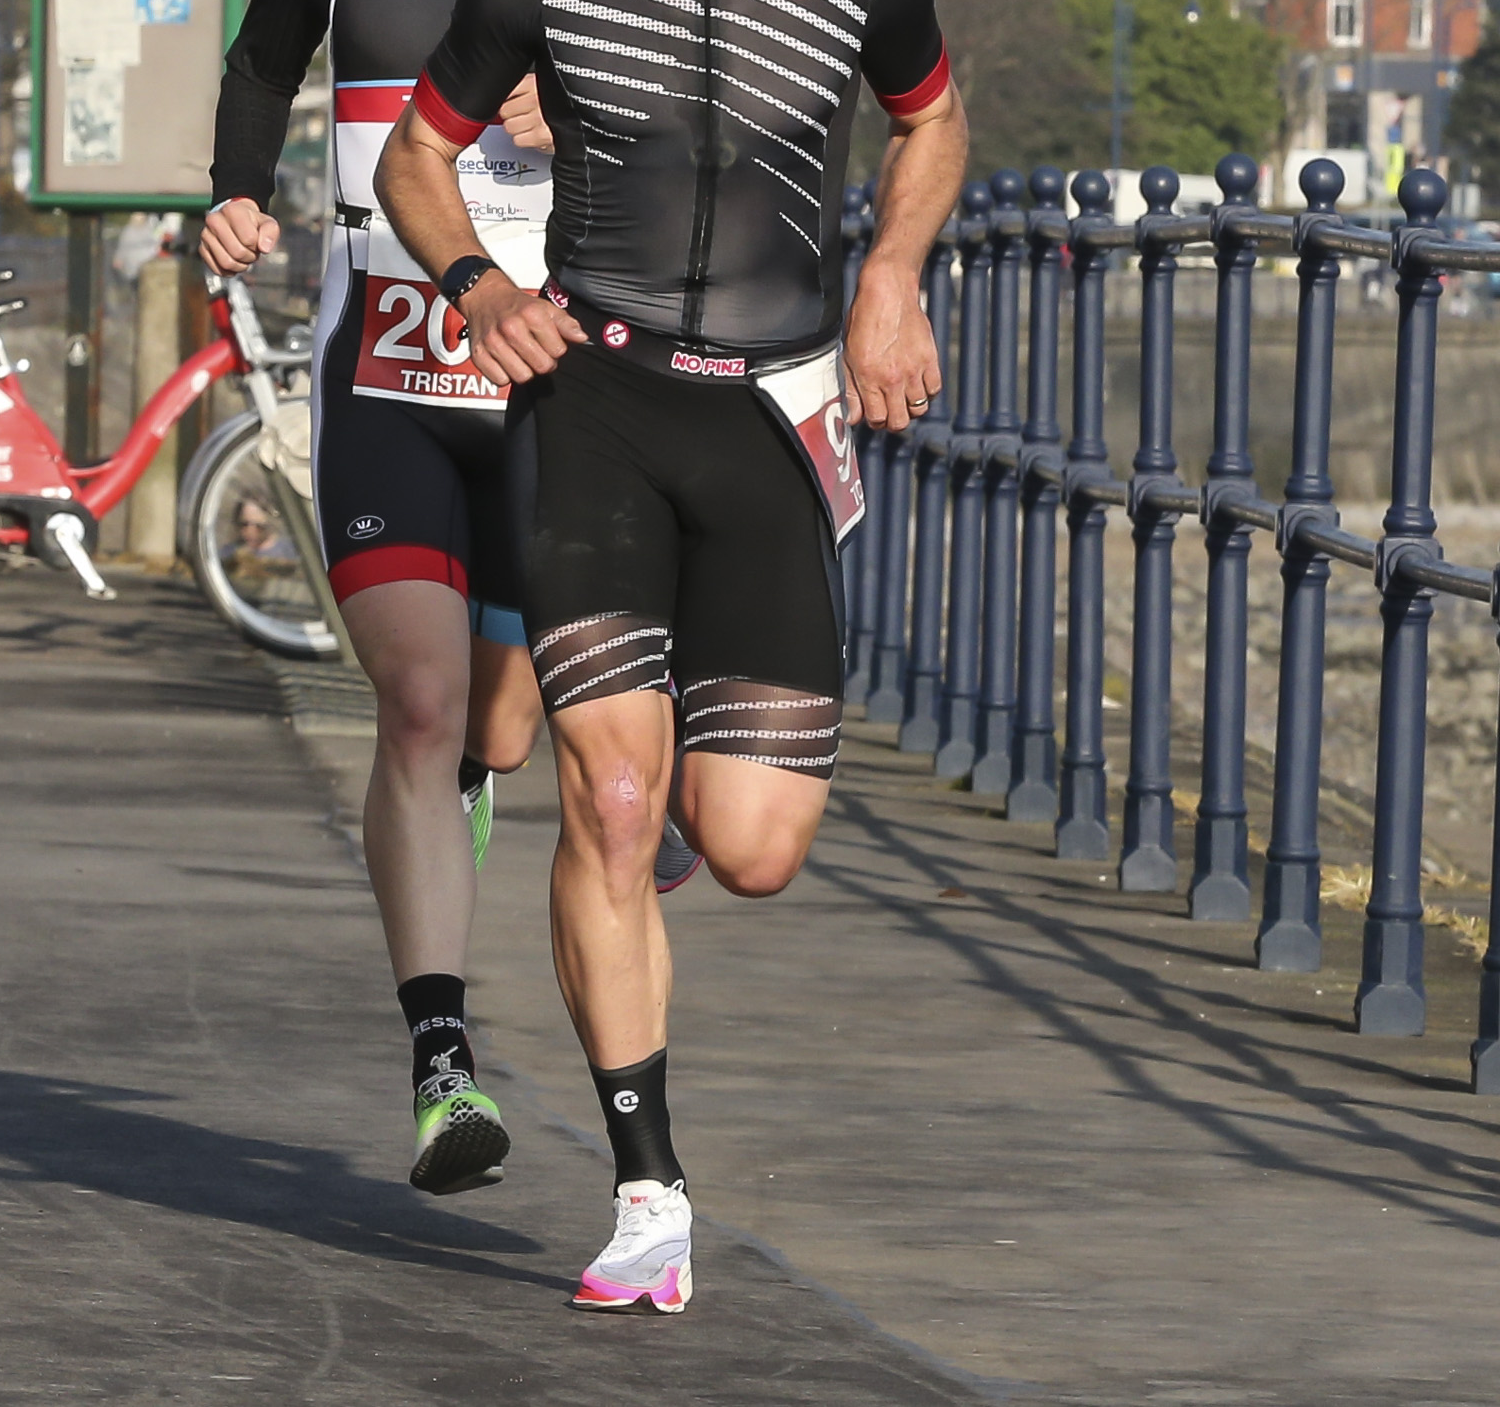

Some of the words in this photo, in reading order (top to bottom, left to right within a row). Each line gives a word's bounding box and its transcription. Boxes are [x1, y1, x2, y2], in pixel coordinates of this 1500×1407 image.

[458, 159, 516, 171] securex
[671, 351, 702, 373] NO
[702, 357, 746, 376] PINZ
[400, 370, 499, 397] TRISTAN
